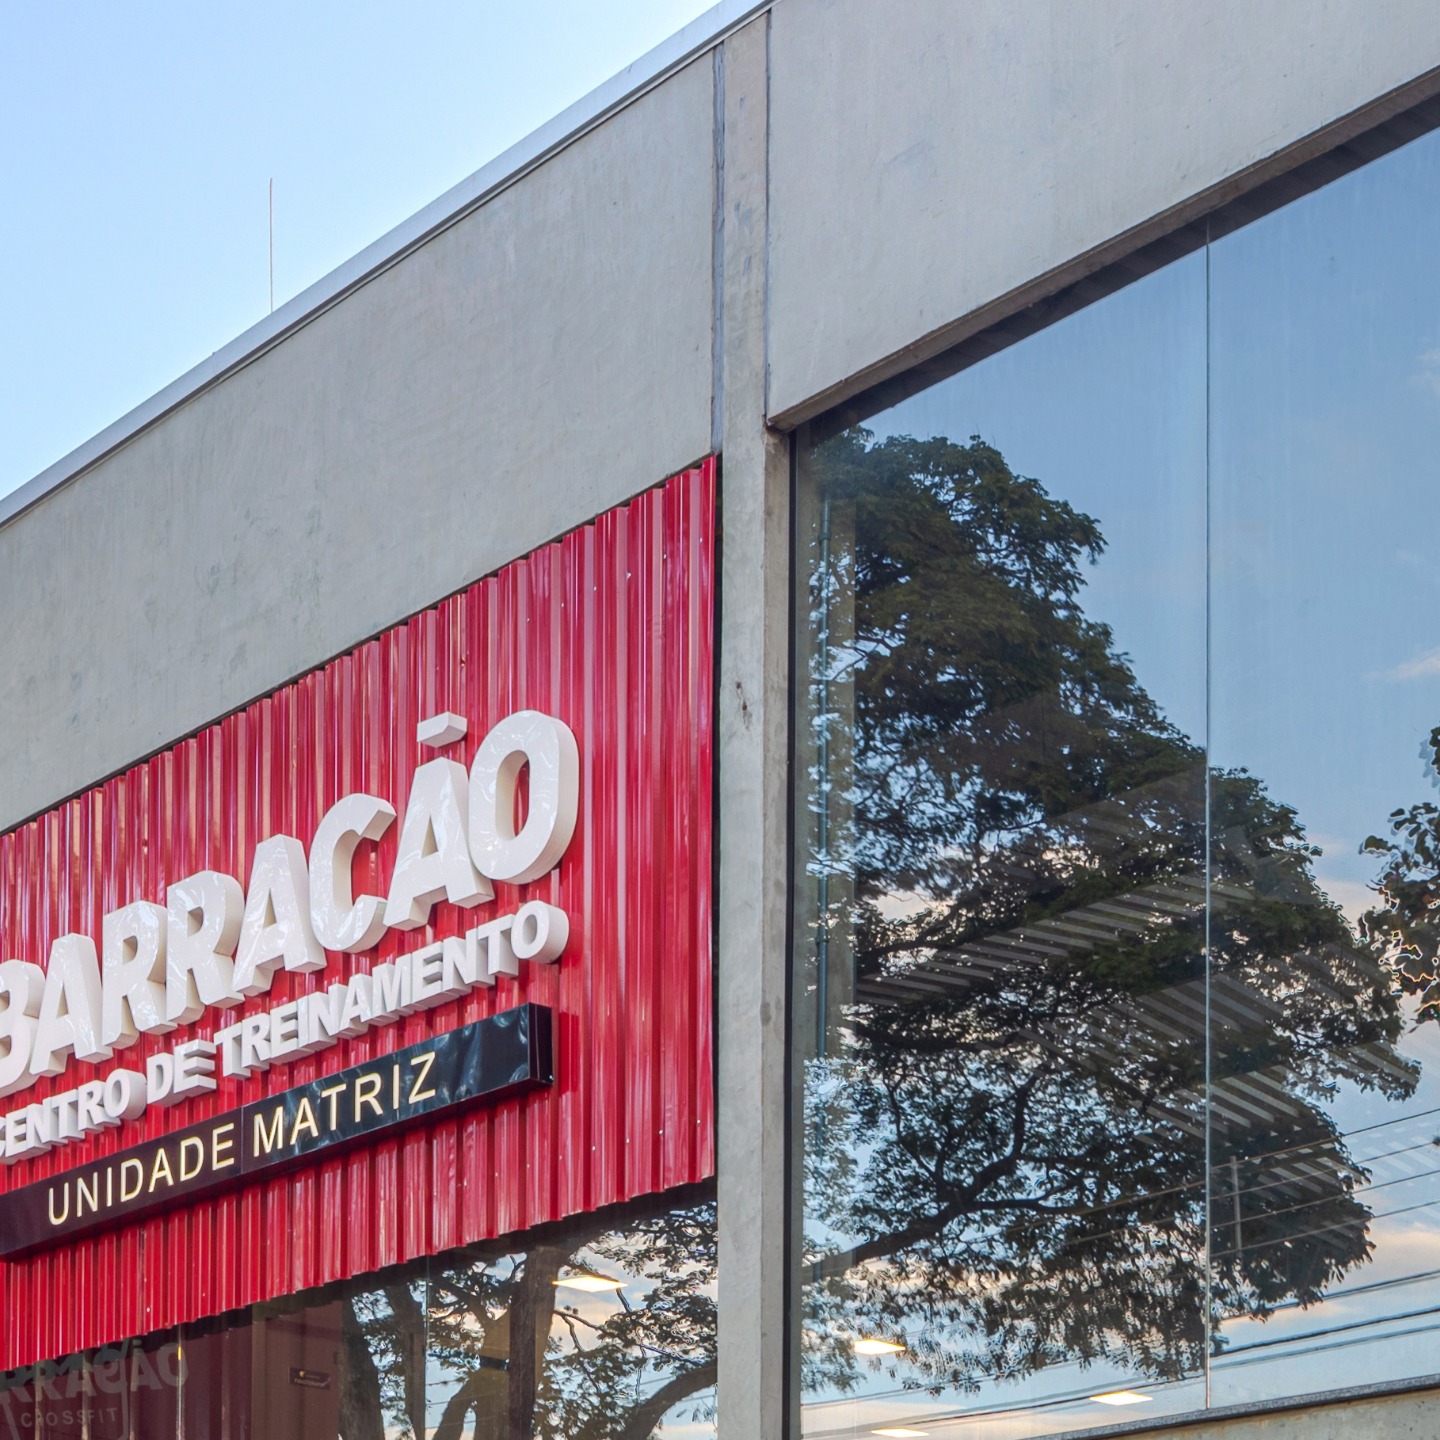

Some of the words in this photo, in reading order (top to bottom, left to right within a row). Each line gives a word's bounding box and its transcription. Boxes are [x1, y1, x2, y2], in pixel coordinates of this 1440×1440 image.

[146, 1038, 217, 1107] DE
[213, 900, 570, 1080] TREINAMENTO
[47, 1121, 235, 1227] UNIDADE
[252, 1050, 438, 1158] MATRIZ
[20, 1407, 118, 1428] CROSSFIT
